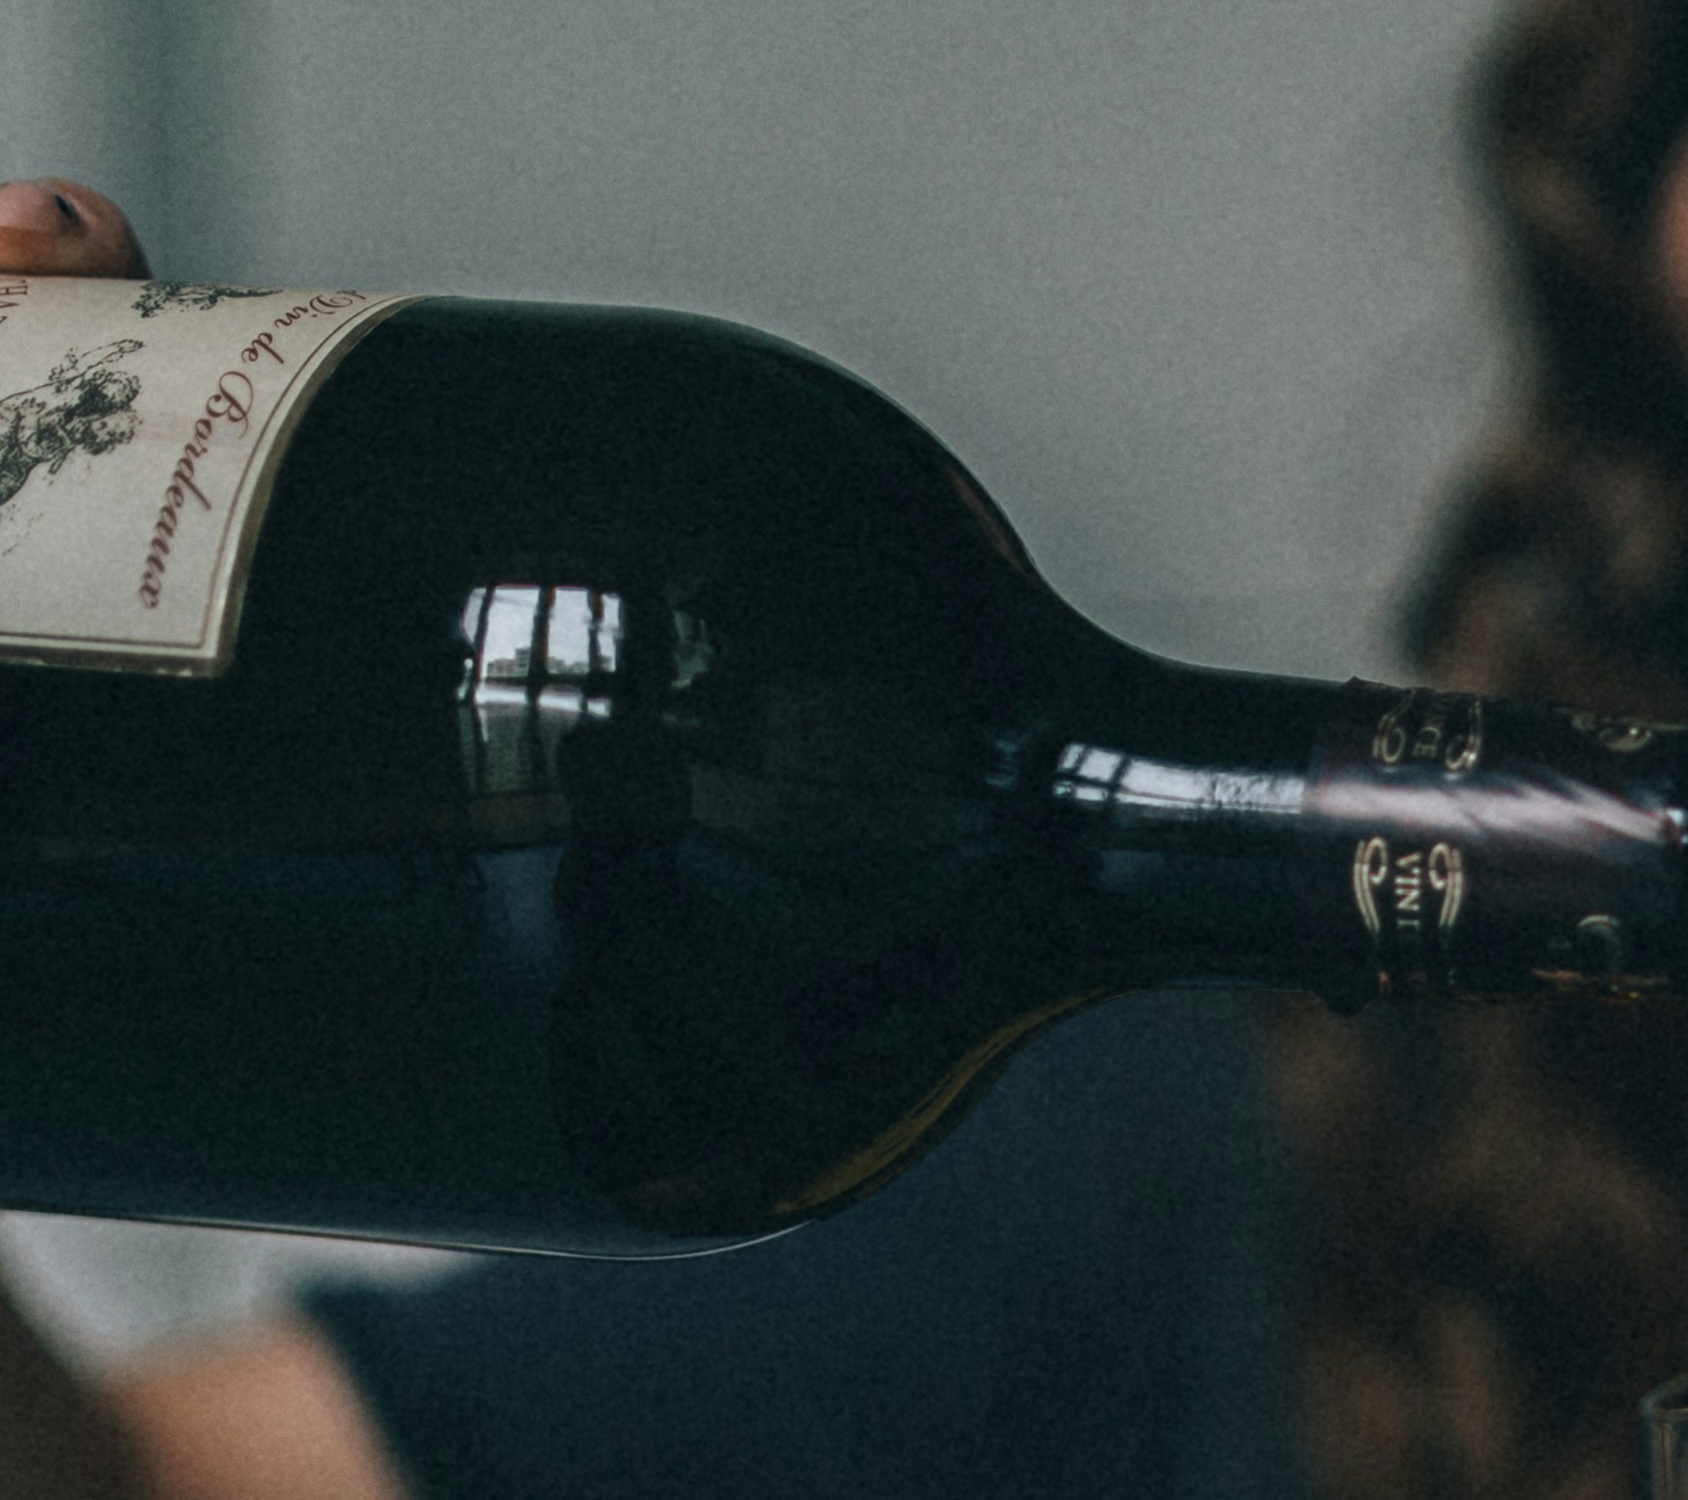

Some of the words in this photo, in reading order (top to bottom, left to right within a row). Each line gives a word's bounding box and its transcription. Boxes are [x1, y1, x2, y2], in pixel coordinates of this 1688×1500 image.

[274, 294, 354, 329] Vin
[240, 331, 285, 366] de
[139, 370, 255, 610] Bordeaux
